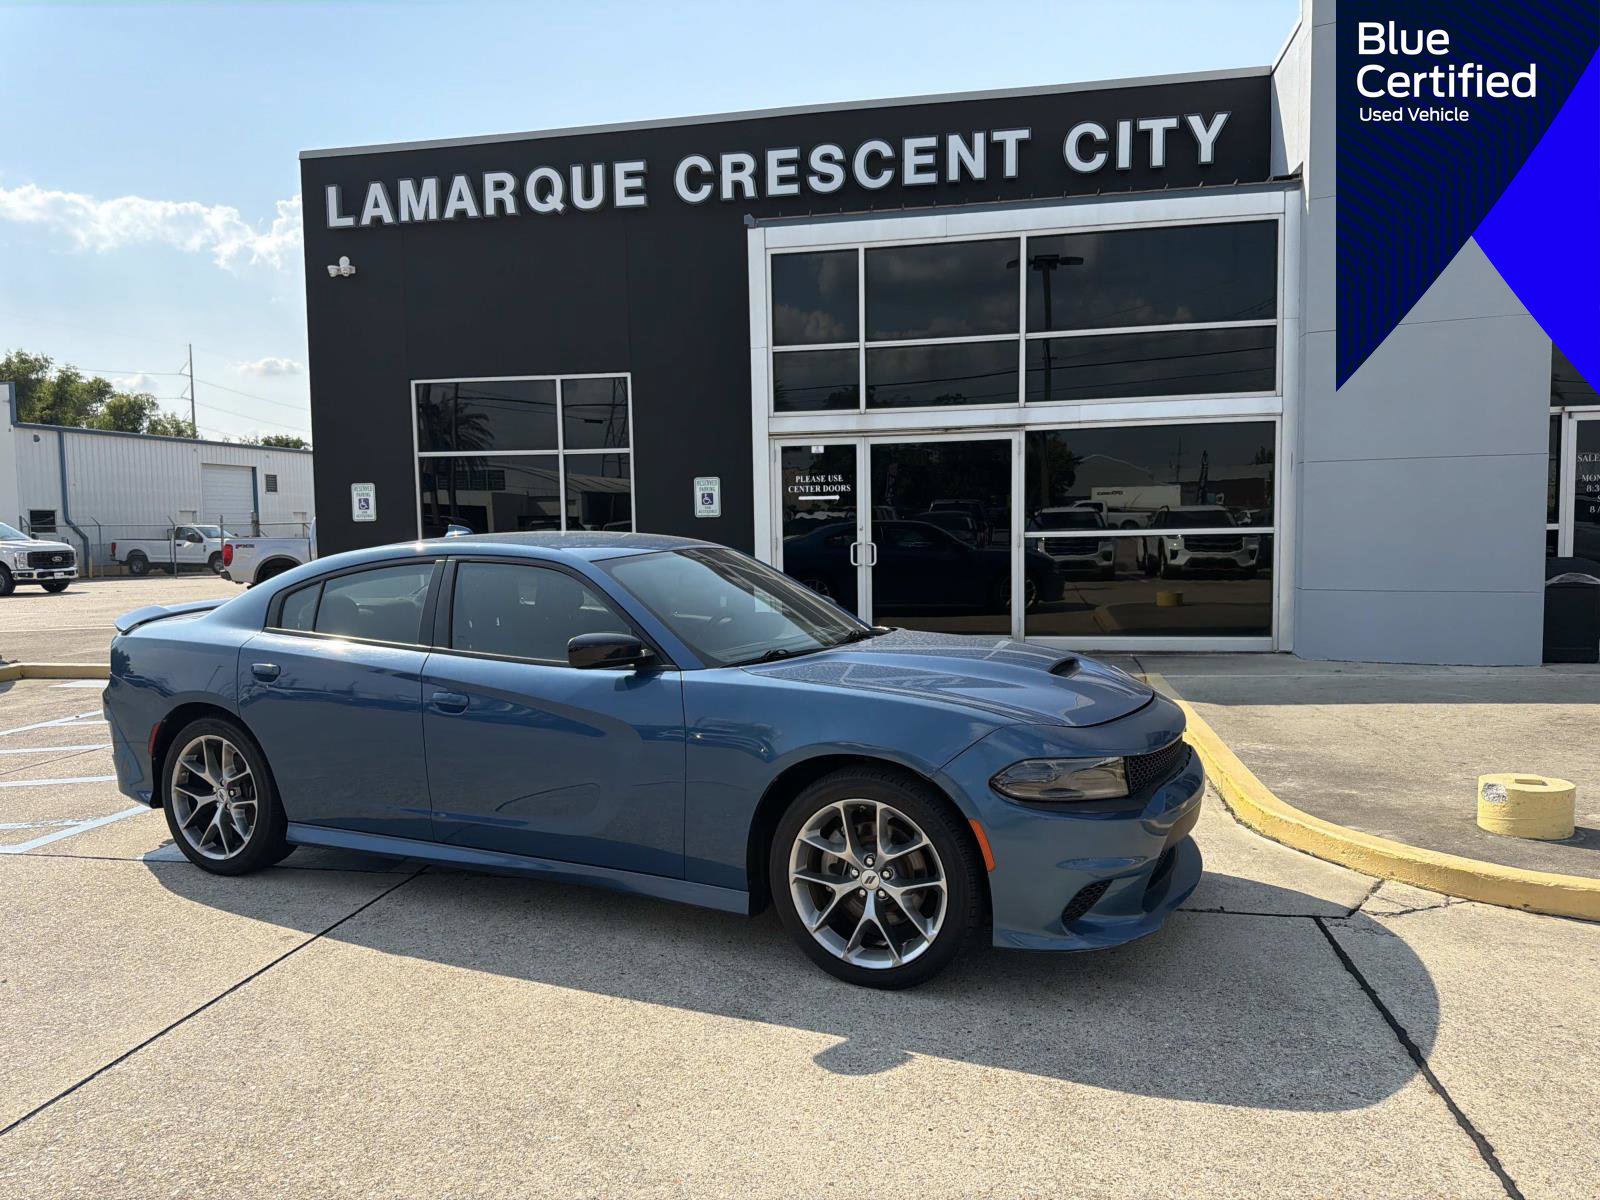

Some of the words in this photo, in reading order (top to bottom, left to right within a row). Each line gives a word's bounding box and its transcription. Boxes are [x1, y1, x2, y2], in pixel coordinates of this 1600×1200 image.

[325, 160, 648, 228] LAMARQUE
[673, 127, 1031, 204] CRESCENT
[1063, 111, 1231, 174] CITY
[795, 475, 827, 483] PLEASE
[828, 474, 843, 482] USE
[788, 485, 821, 493] CENTER
[822, 484, 851, 492] DOORS
